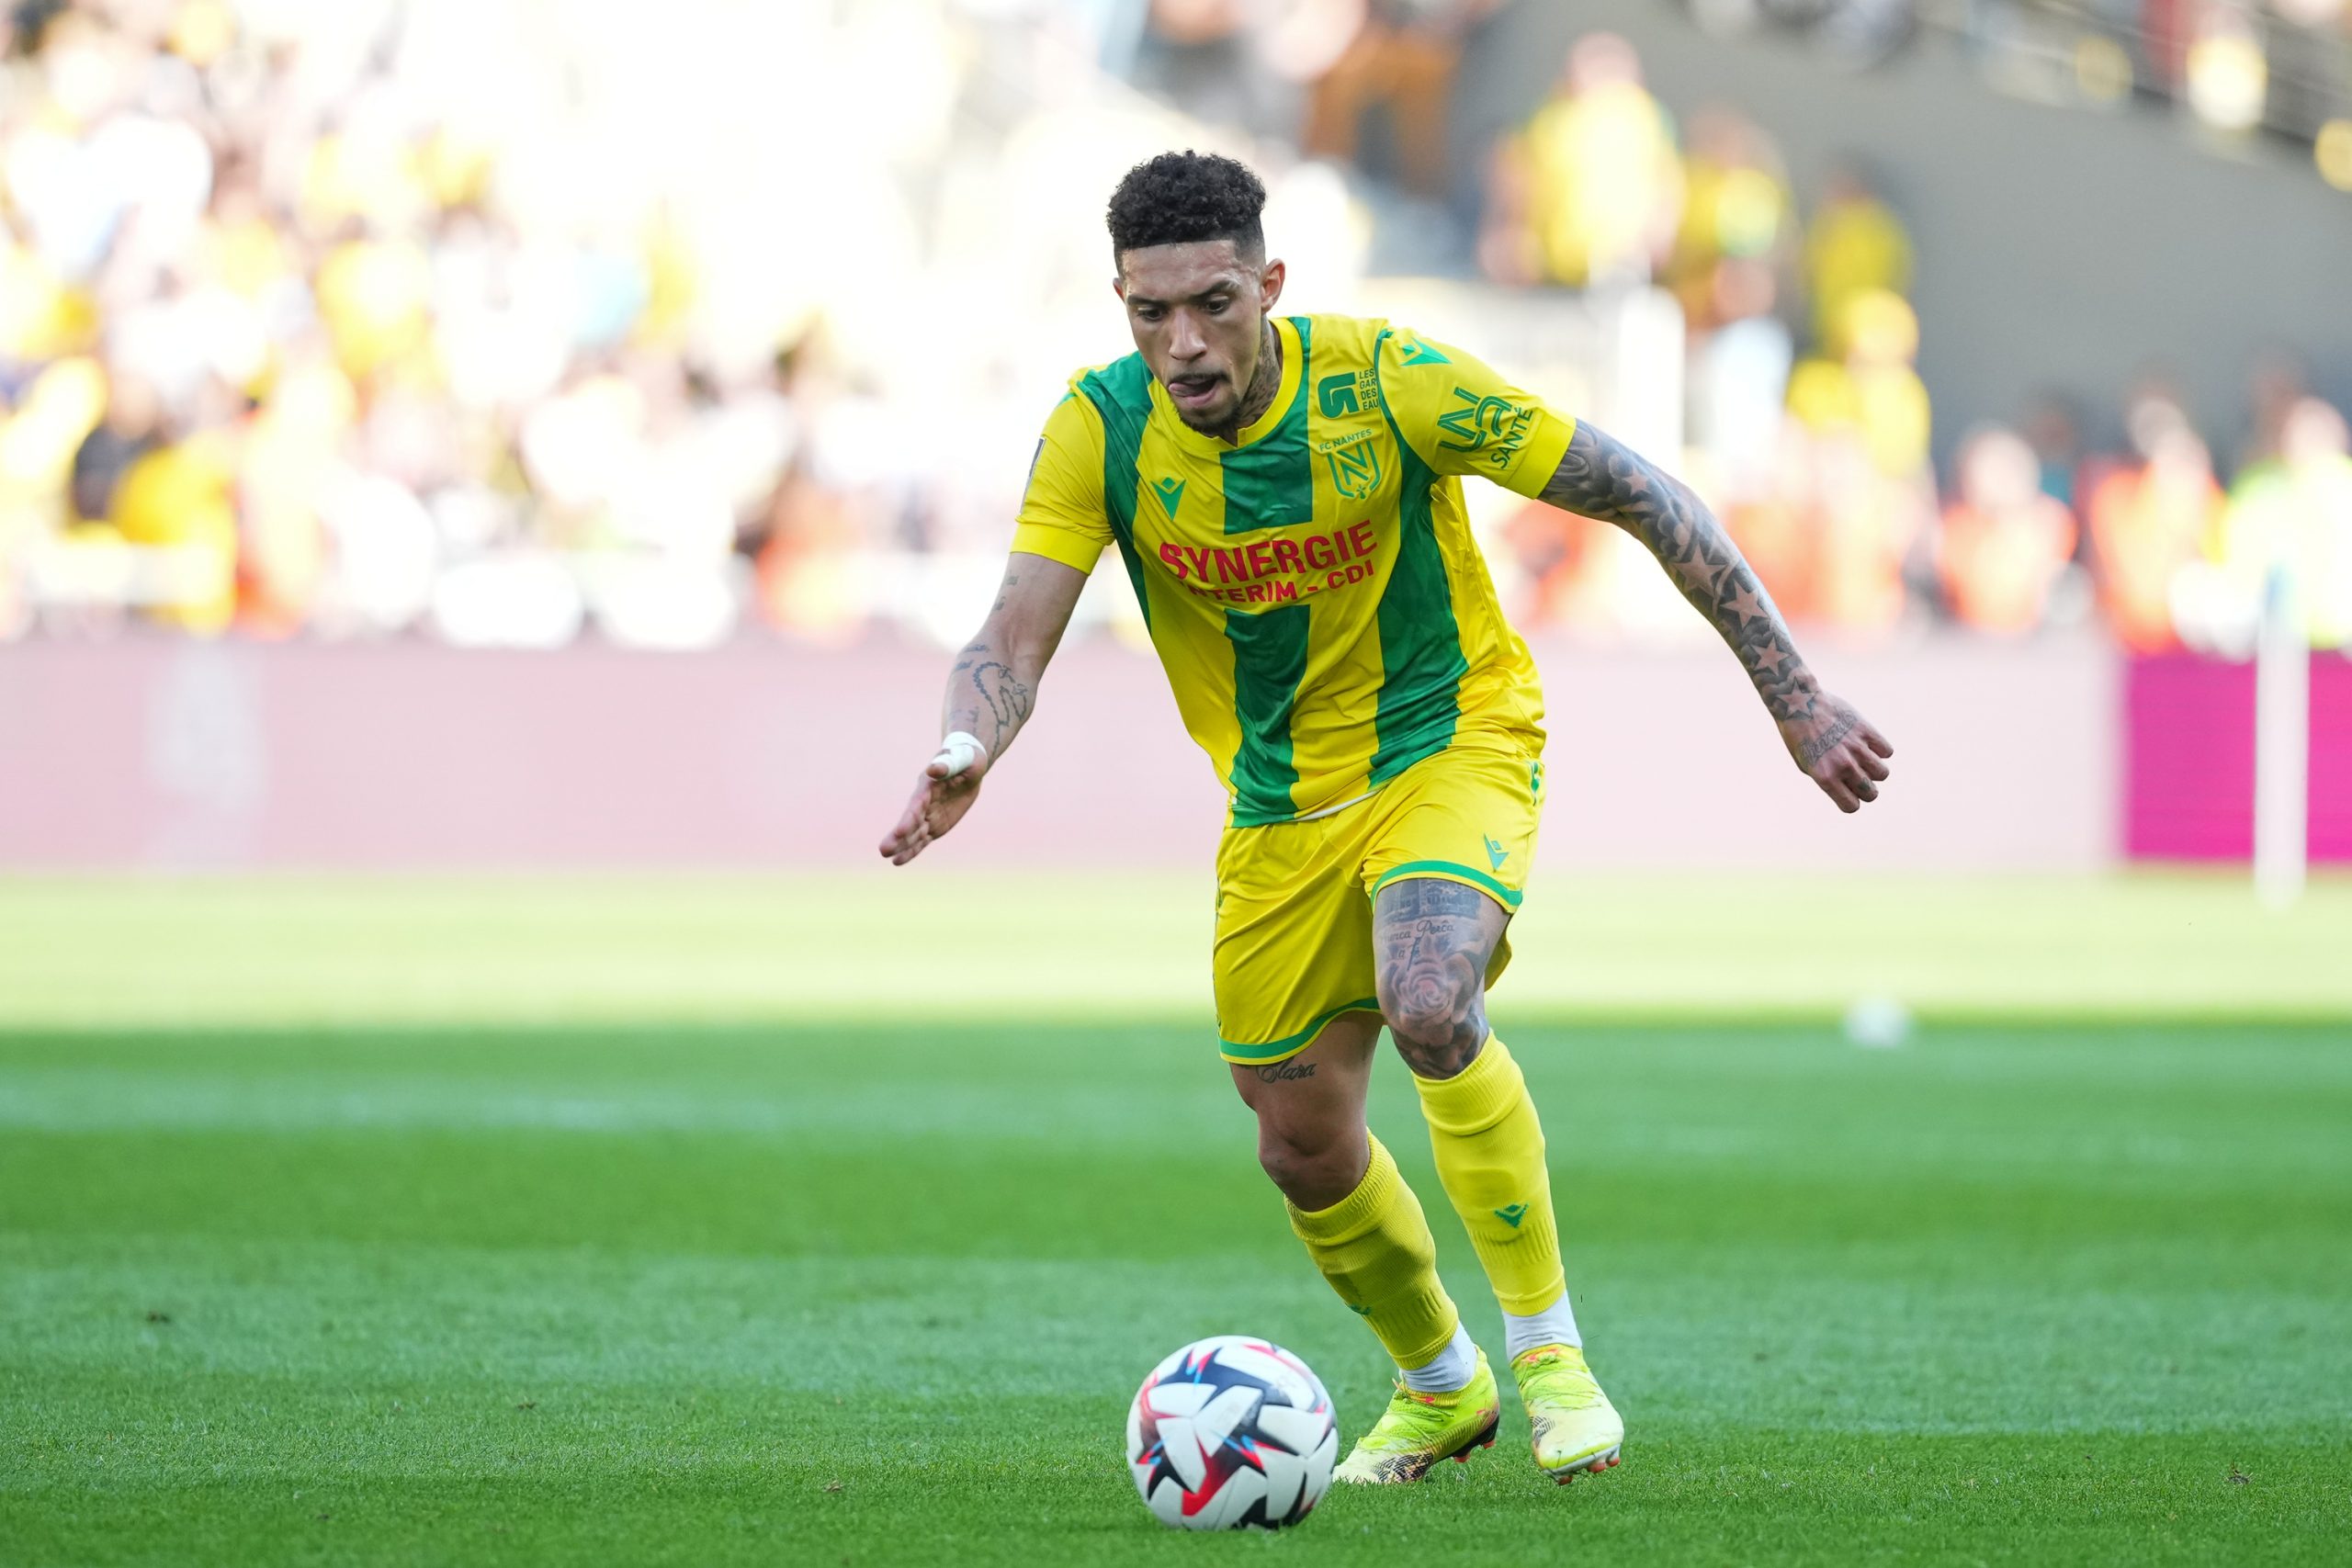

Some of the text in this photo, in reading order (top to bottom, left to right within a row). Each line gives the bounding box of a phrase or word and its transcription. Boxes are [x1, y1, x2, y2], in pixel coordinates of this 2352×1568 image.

[1359, 368, 1374, 379] LES
[1360, 388, 1377, 400] DES
[1319, 428, 1372, 452] FC NANTES
[1490, 406, 1535, 469] SANTÉ
[1159, 519, 1377, 584] SYNERGIE
[1327, 559, 1374, 590] CDI
